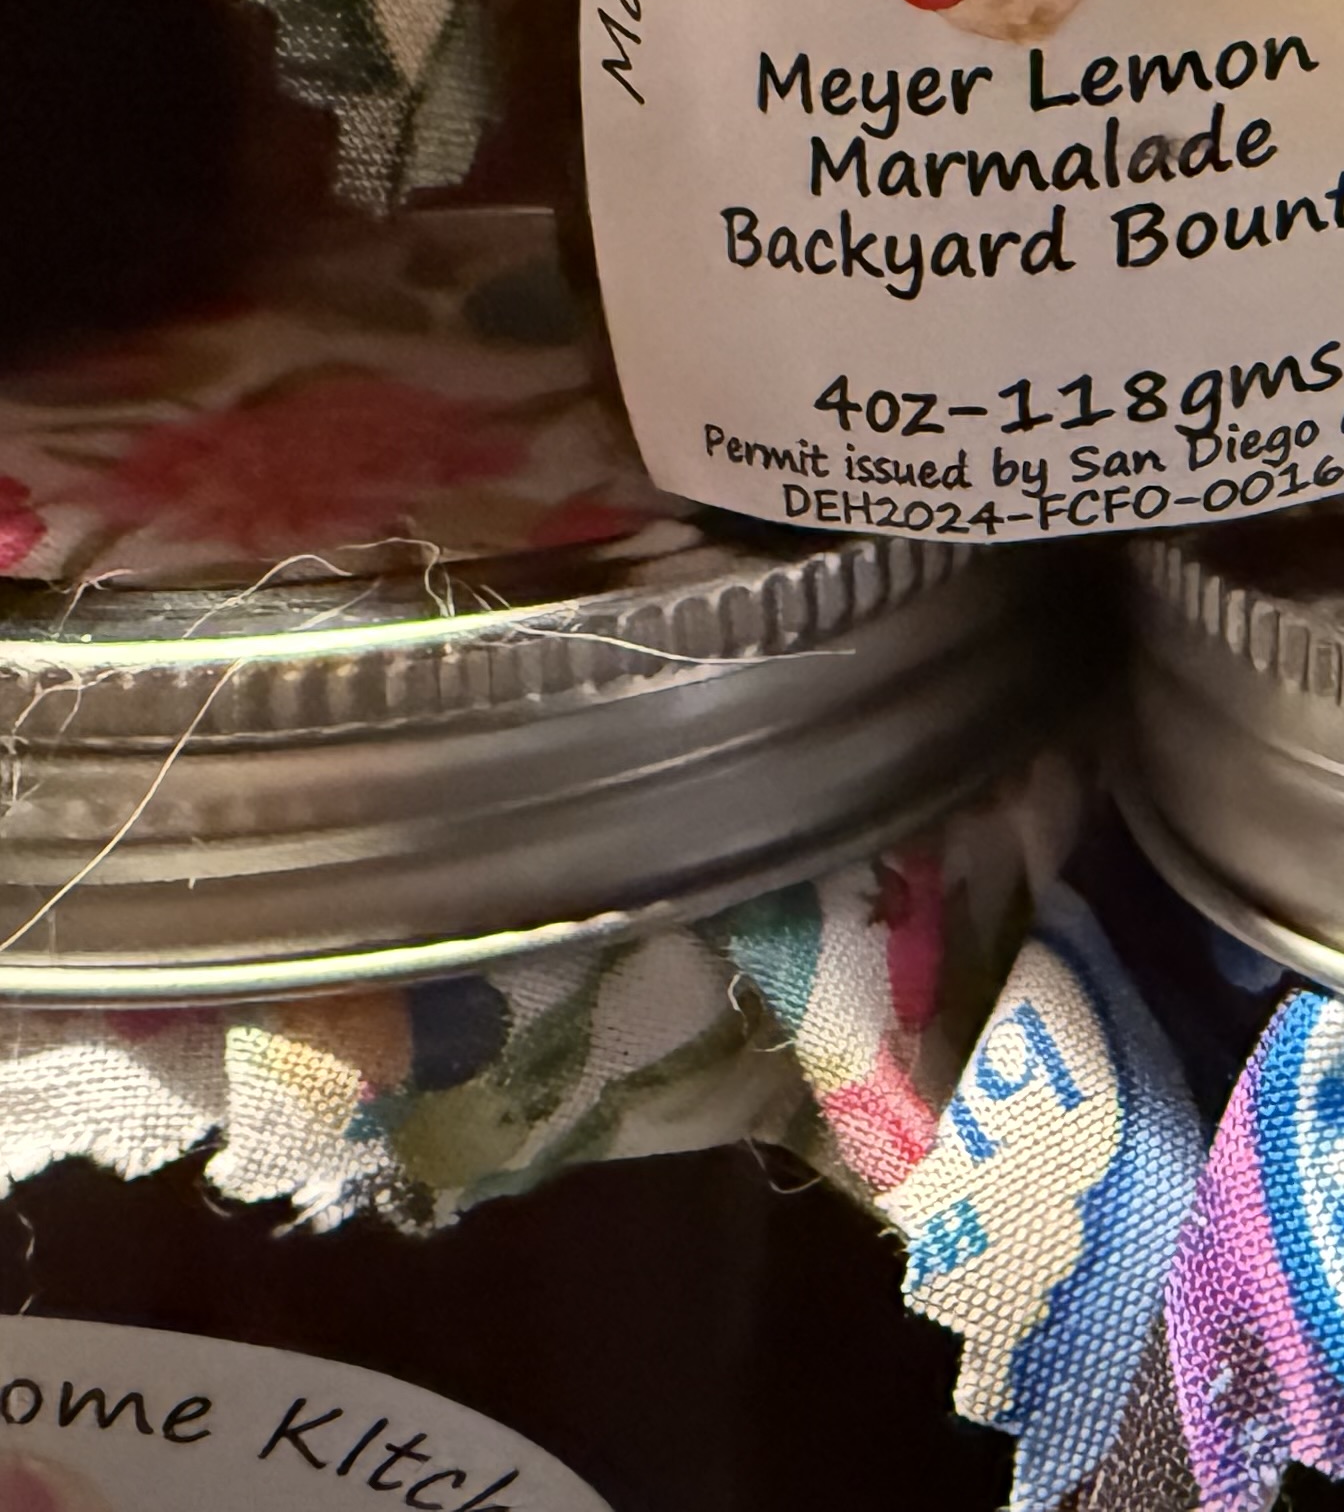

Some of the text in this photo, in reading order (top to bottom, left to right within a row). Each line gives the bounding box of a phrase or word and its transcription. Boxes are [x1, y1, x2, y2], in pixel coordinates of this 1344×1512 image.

[758, 29, 1319, 138] Meyer Lemon
[808, 102, 1279, 198] Marmalade
[720, 205, 1074, 301] Backyard
[815, 341, 1342, 437] 4oz-118gms
[703, 421, 831, 478] Permit
[844, 444, 969, 490] issued
[991, 446, 1047, 497] by
[1070, 433, 1164, 482] San
[1186, 413, 1319, 470] Diego
